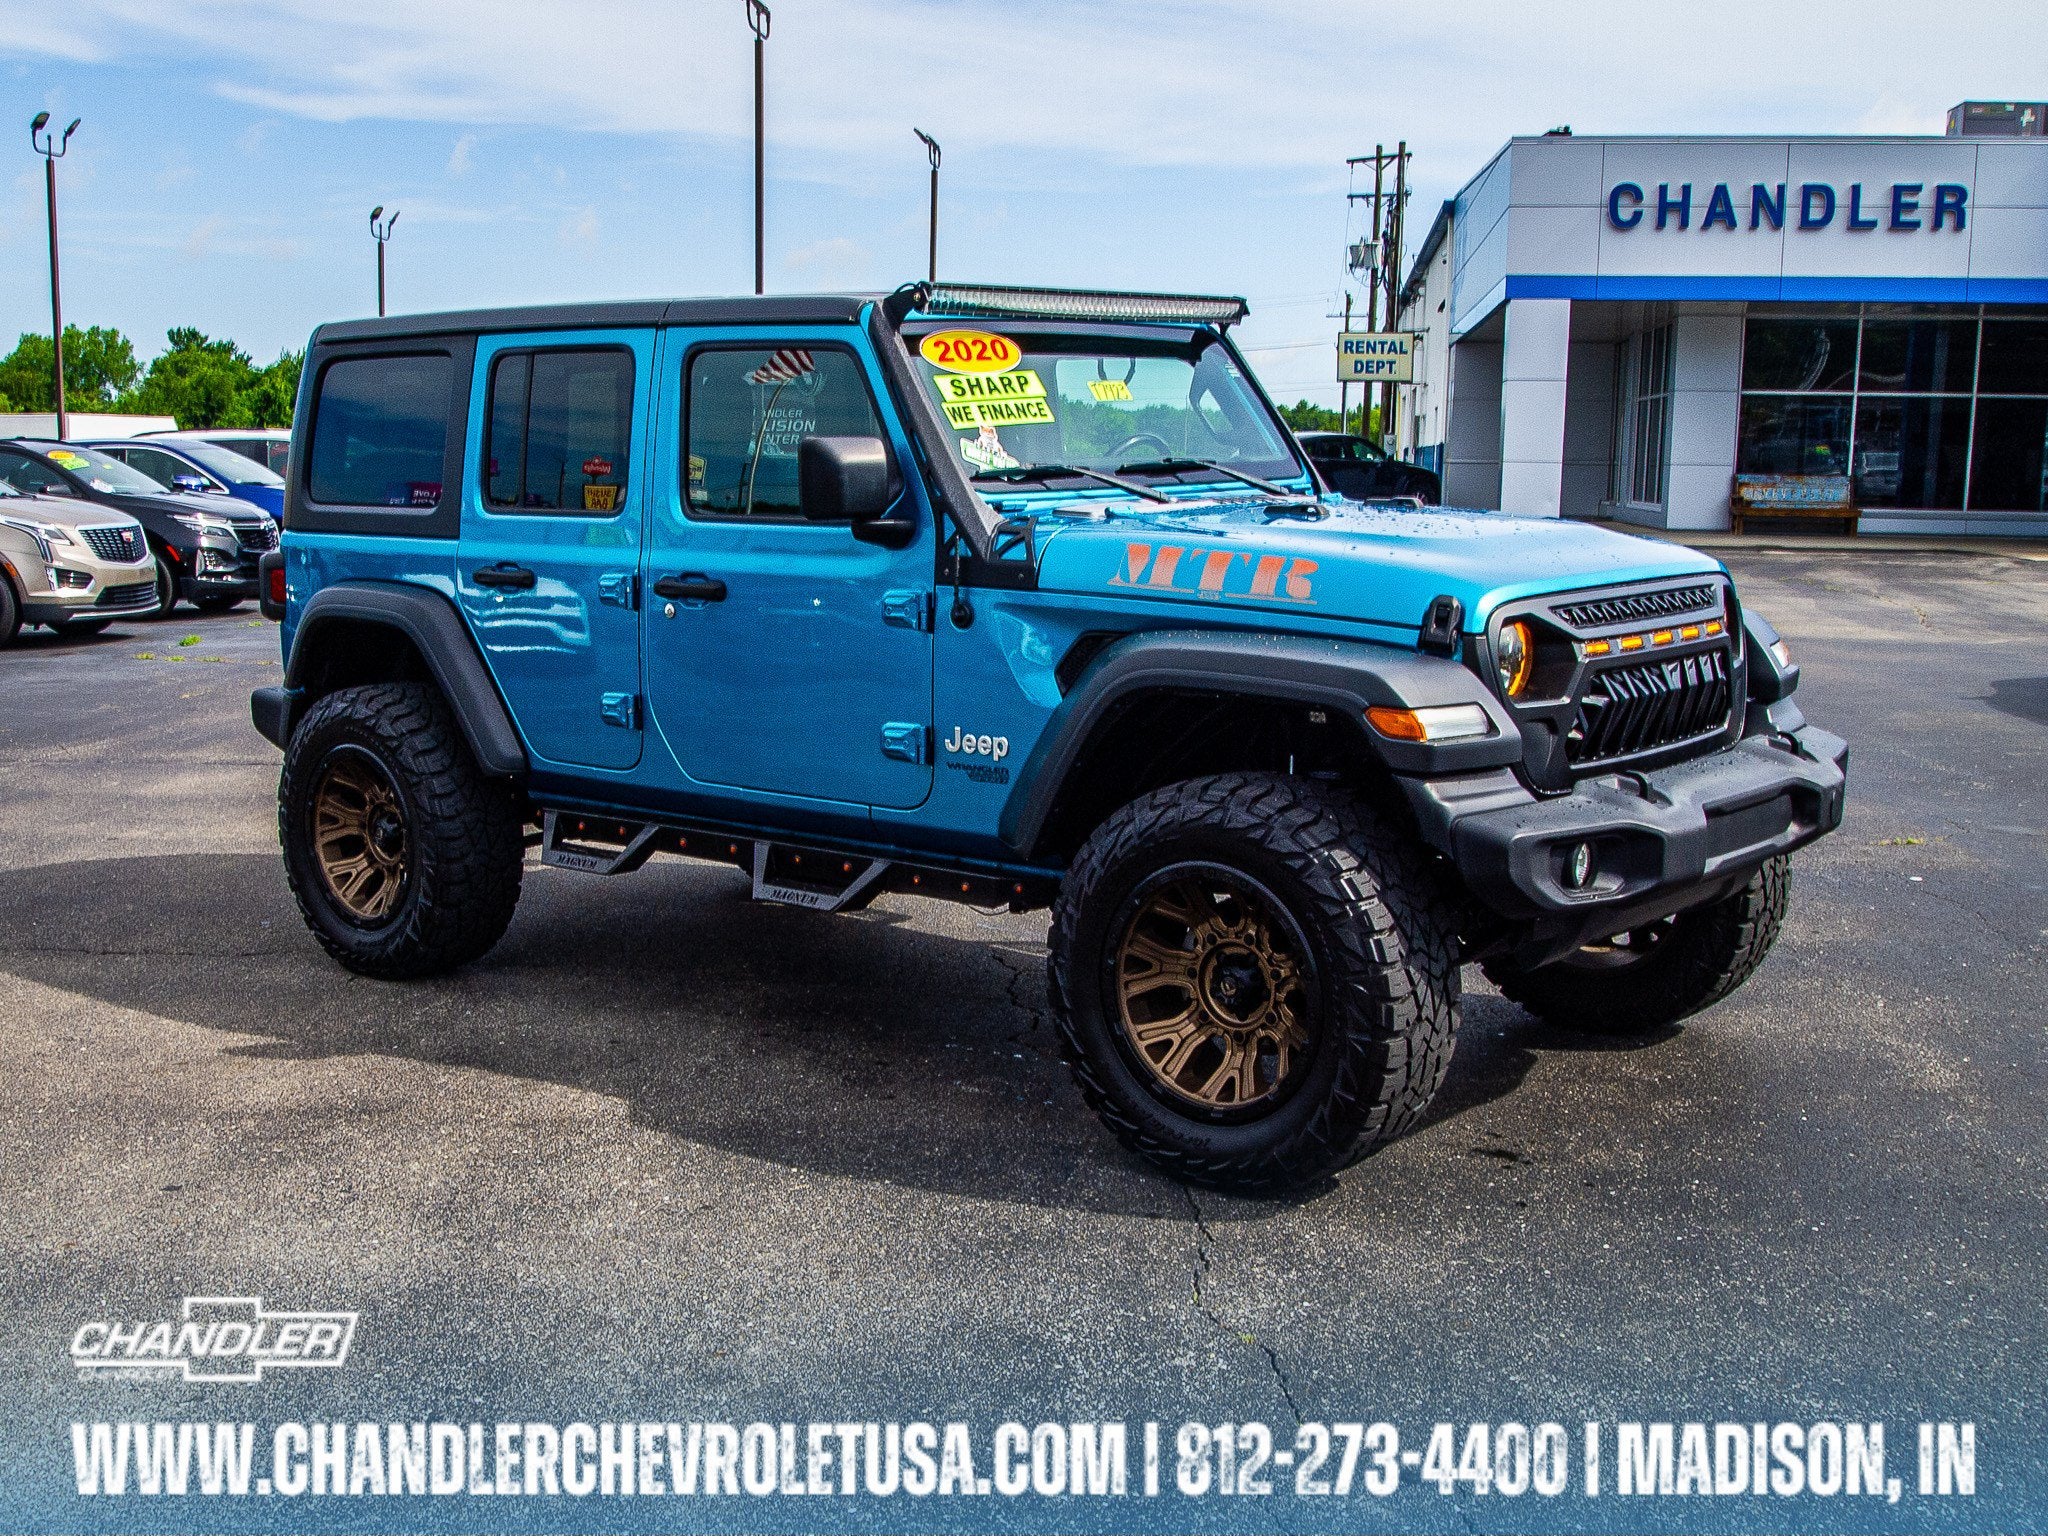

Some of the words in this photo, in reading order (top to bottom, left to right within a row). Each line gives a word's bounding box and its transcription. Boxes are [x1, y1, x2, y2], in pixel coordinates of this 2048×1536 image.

[1607, 181, 1970, 230] CHANDLER
[933, 338, 1009, 362] 2020
[1343, 340, 1408, 355] RENTAL
[1353, 360, 1397, 375] DEPT.
[950, 374, 1029, 398] SHARP
[947, 404, 974, 423] WE
[979, 401, 1048, 421] FINANCE
[1107, 543, 1319, 601] MTR
[945, 726, 1008, 761] Jeep
[770, 889, 819, 906] MAGNUM
